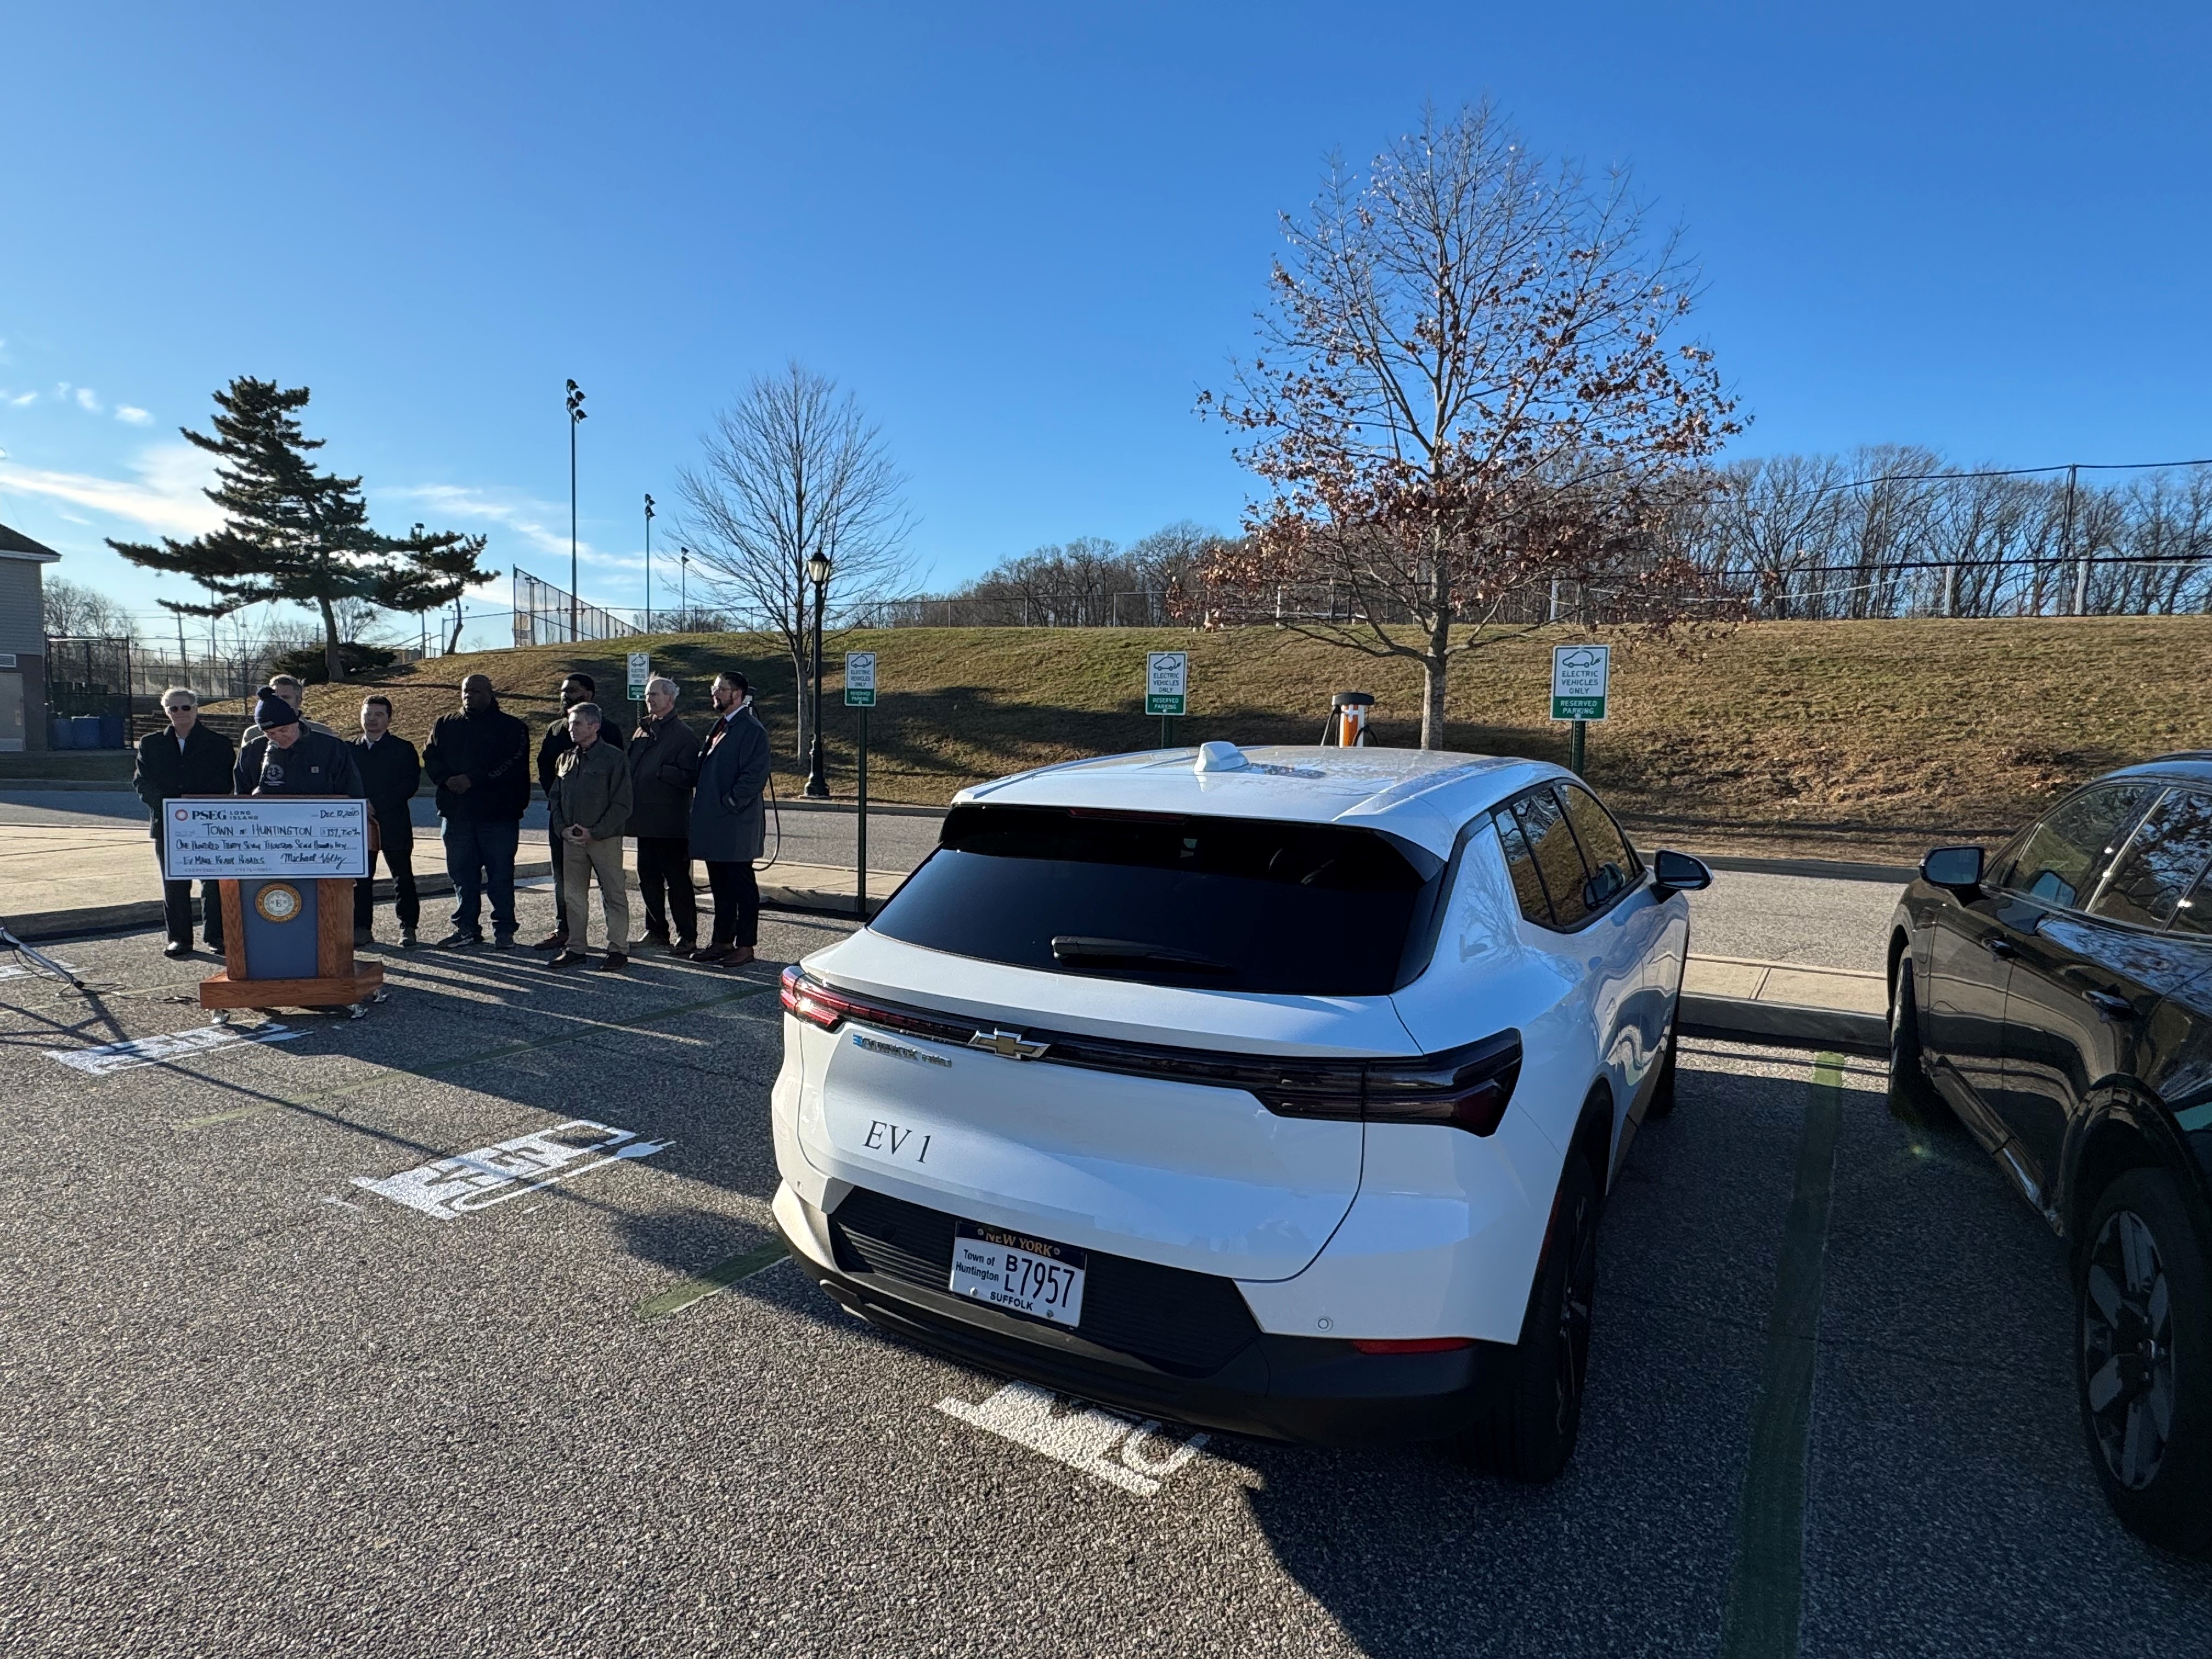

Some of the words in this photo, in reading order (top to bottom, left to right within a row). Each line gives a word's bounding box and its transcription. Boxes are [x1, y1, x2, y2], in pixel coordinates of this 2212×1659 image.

[192, 809, 227, 821] PSEG
[252, 823, 312, 837] HUNTINGTON
[862, 1119, 913, 1155] EV
[916, 1135, 932, 1164] 1
[985, 1232, 1017, 1247] NEW
[1019, 1237, 1053, 1257] YORK
[963, 1249, 984, 1263] Town
[986, 1256, 995, 1267] of
[956, 1261, 999, 1282] Huntington
[990, 1291, 1034, 1311] SUFFOLK
